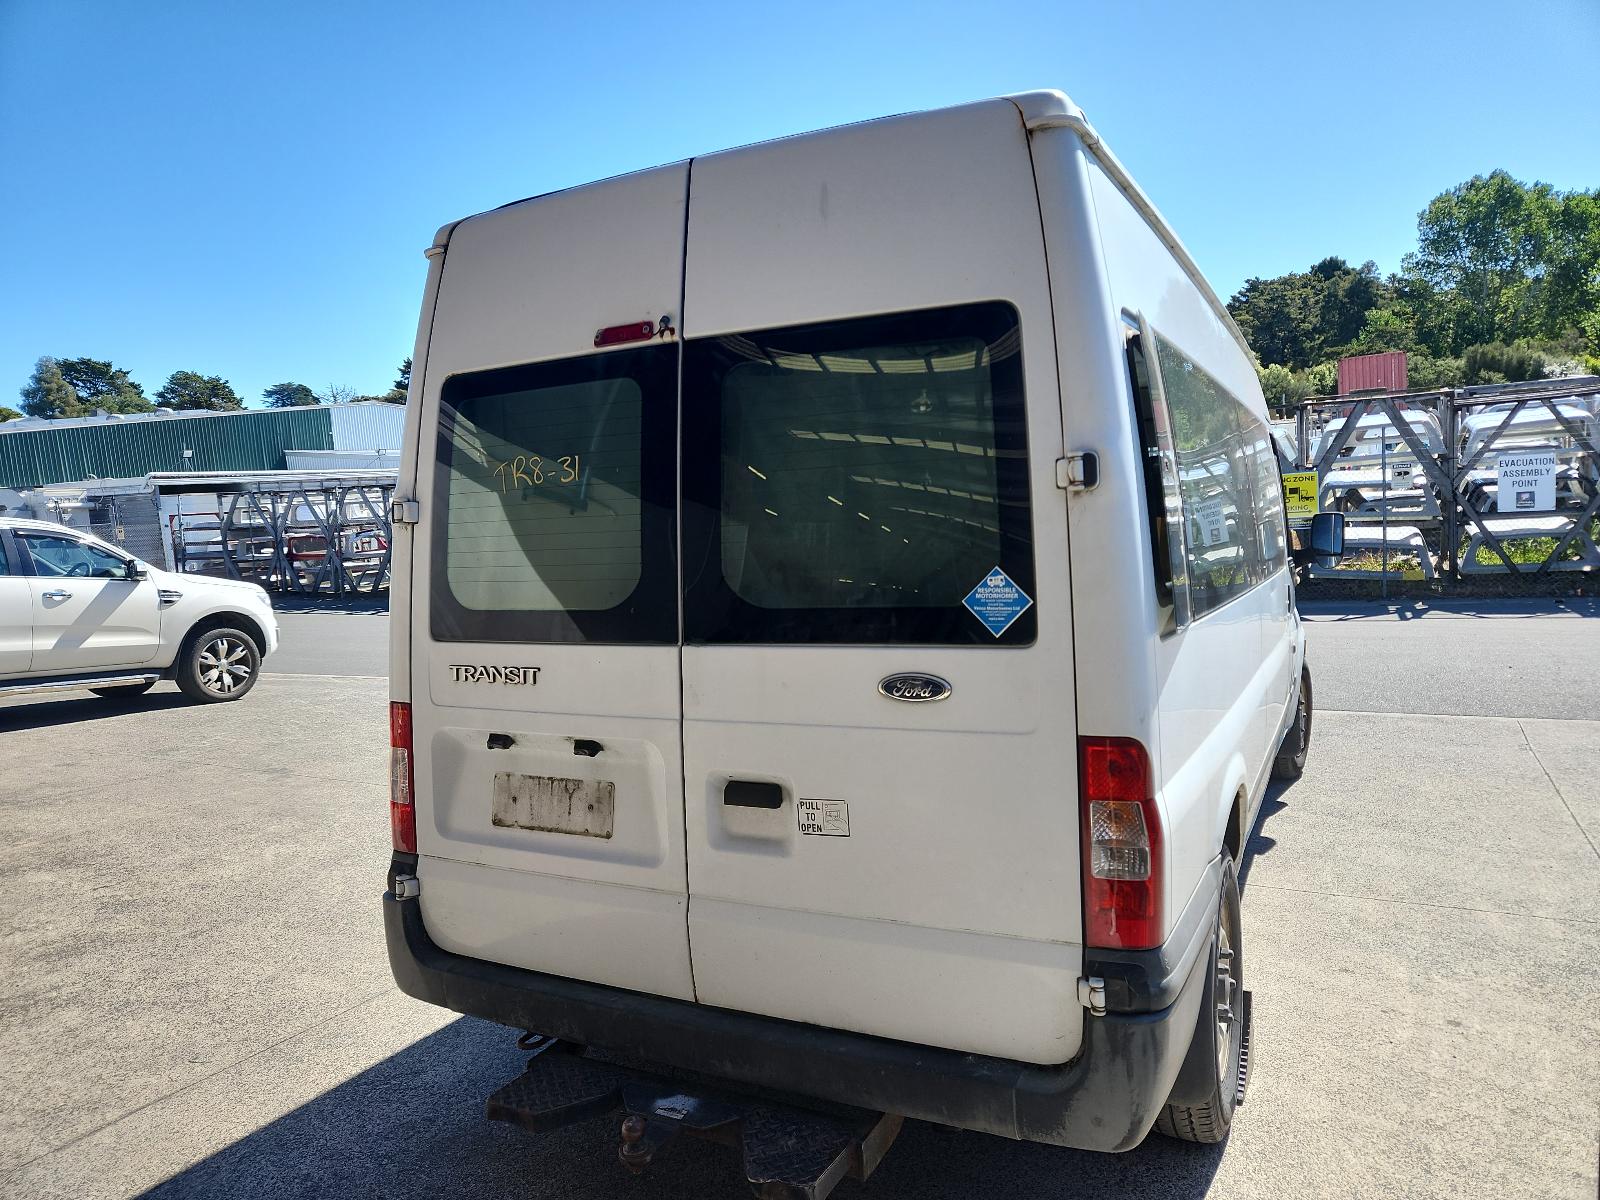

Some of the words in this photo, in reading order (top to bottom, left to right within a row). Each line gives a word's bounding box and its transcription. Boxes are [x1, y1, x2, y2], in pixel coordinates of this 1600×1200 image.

[1499, 457, 1555, 468] EVACUATION
[493, 455, 579, 495] TR8-31
[1503, 468, 1551, 478] ASSEMBLY
[1293, 475, 1315, 483] ZONE
[1512, 479, 1538, 488] POINT
[449, 664, 541, 685] TRANSIT
[892, 680, 933, 697] Ford
[800, 801, 821, 811] PULL
[805, 812, 816, 822] TO
[801, 823, 823, 833] OPEN
